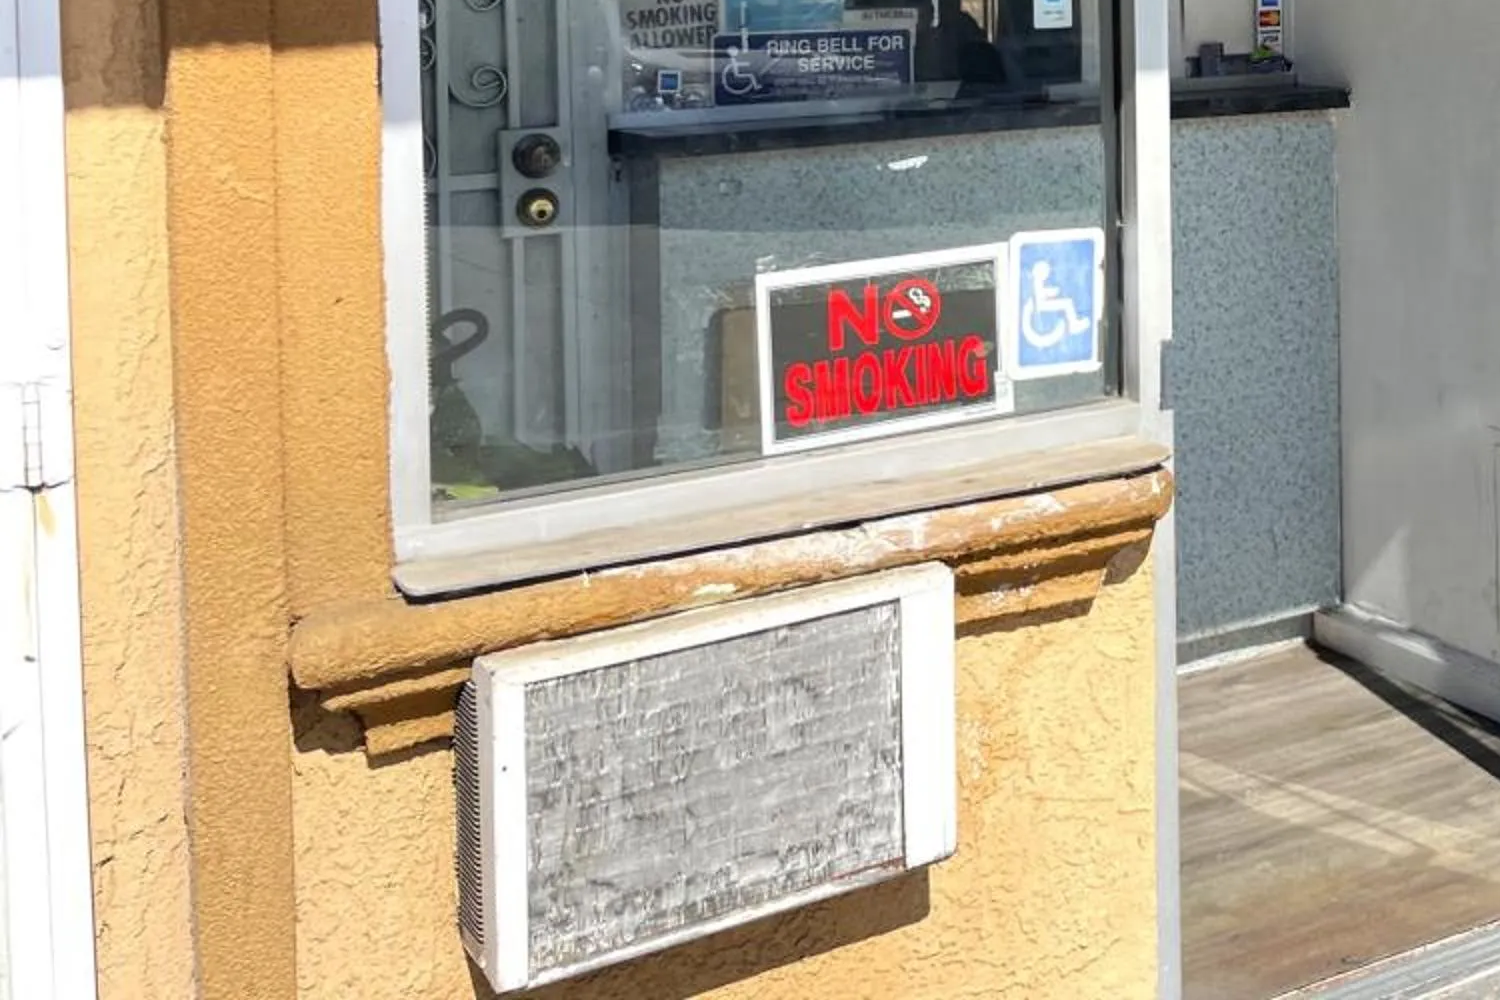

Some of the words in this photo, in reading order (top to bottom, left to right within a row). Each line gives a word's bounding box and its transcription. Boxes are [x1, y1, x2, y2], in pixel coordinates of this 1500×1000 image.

[626, 3, 717, 30] SMOKING
[766, 38, 811, 56] RING
[817, 37, 863, 54] BELL
[868, 35, 904, 51] FOR
[797, 54, 876, 73] SERVICE
[827, 276, 942, 352] NO
[784, 335, 989, 428] SMOKING
